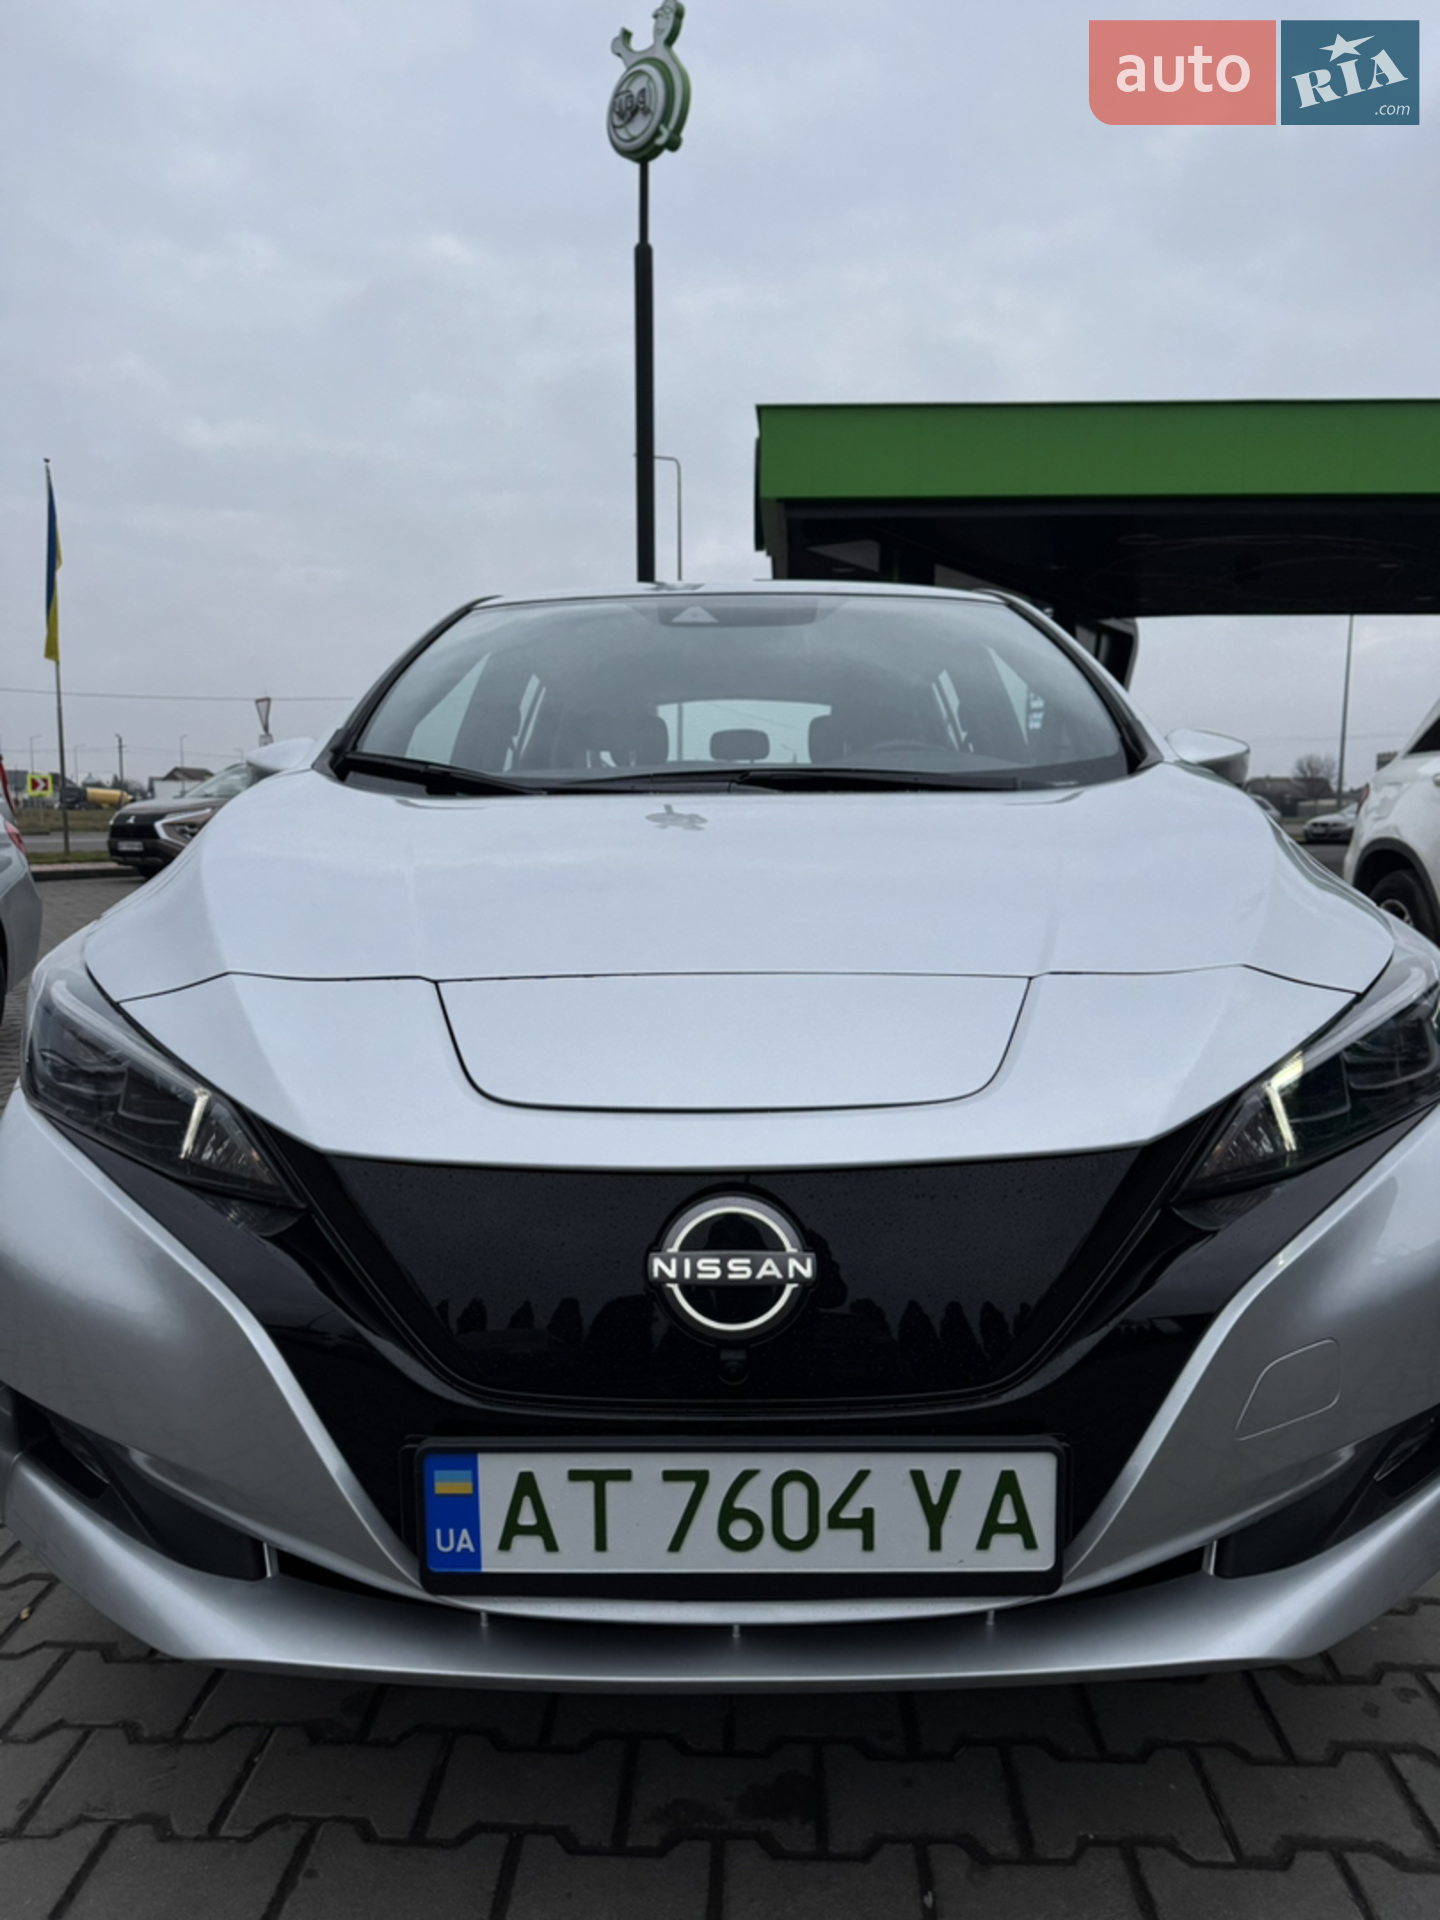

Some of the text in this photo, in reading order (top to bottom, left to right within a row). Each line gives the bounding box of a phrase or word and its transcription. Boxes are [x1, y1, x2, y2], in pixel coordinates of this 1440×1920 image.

[652, 1257, 813, 1280] NISSAN
[497, 1469, 1039, 1552] AT 7604 YA
[435, 1528, 475, 1553] UA
